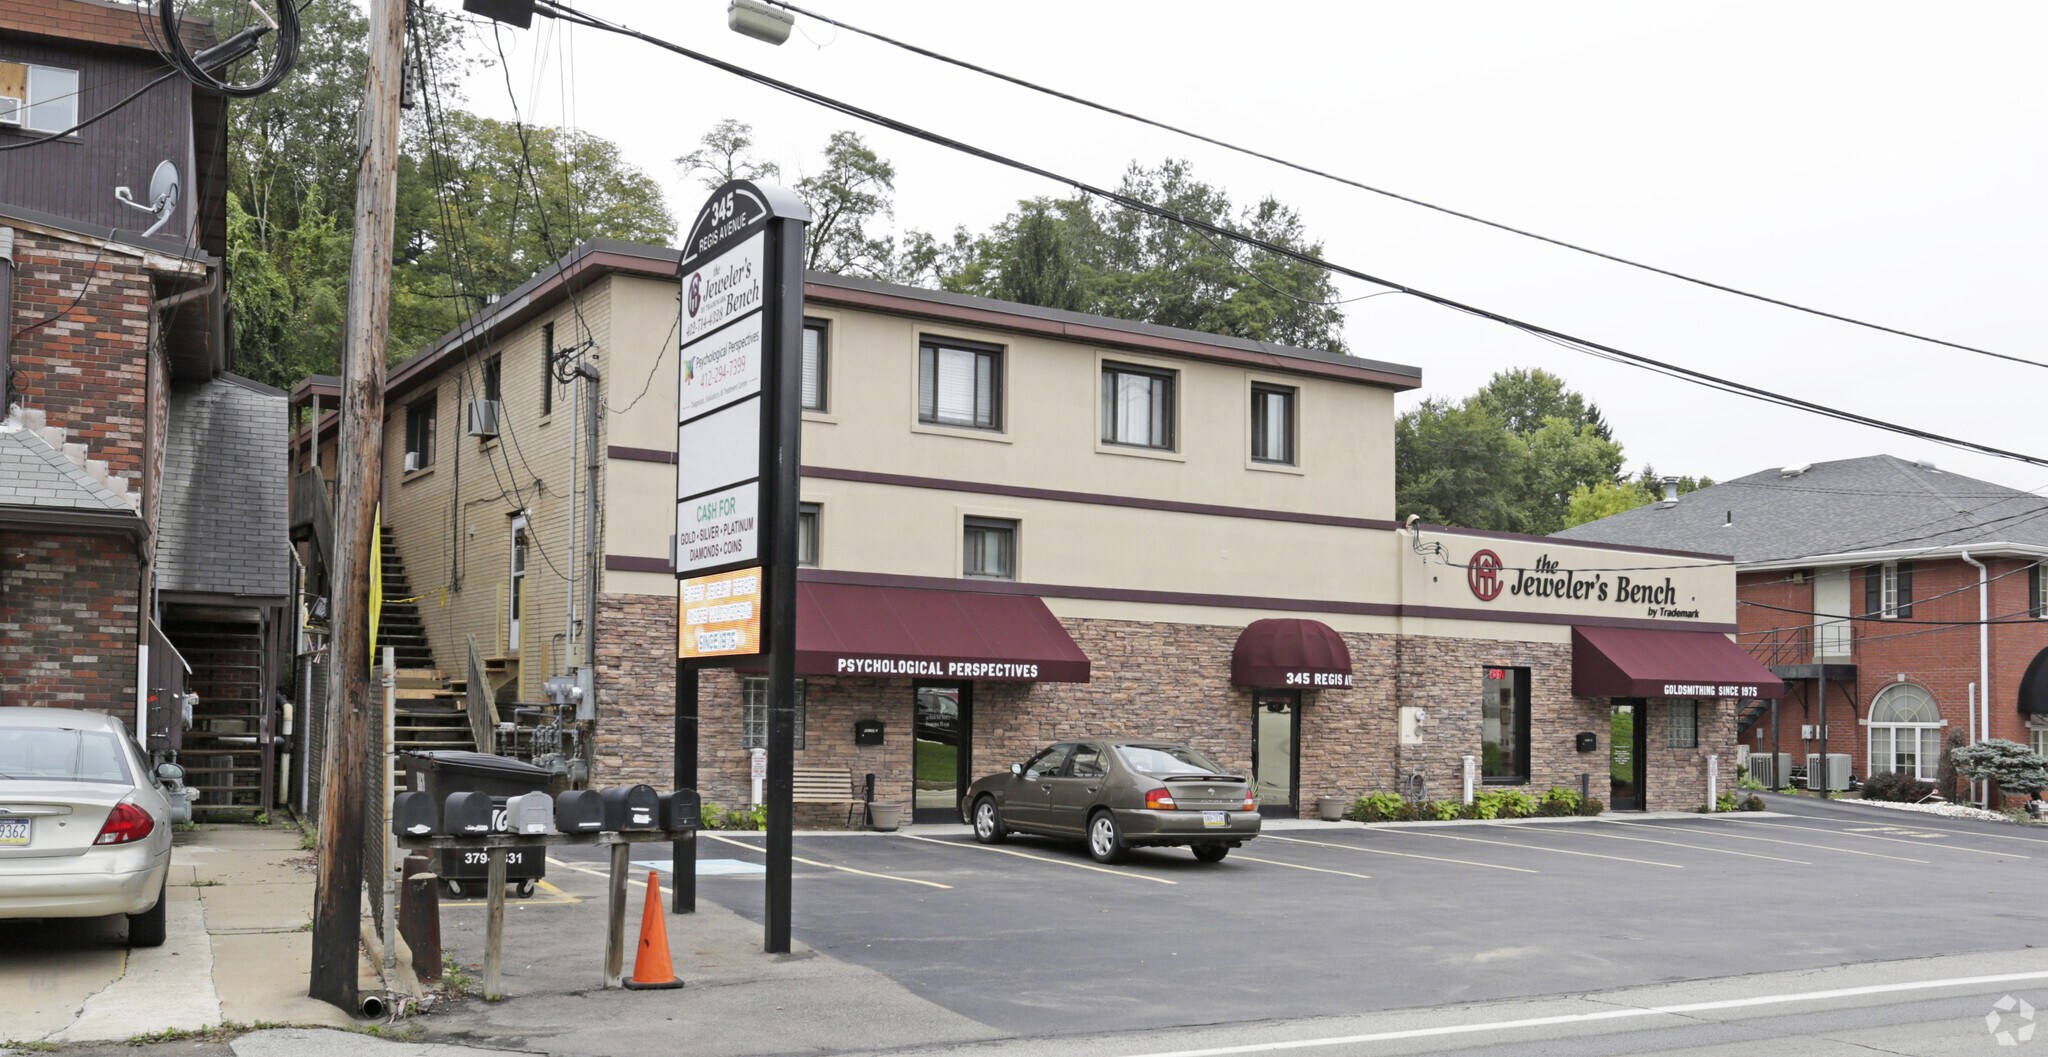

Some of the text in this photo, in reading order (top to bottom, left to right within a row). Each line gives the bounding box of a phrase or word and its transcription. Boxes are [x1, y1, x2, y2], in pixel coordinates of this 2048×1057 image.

[711, 192, 734, 227] 345
[699, 212, 746, 252] REGIS AVENUE
[703, 258, 752, 302] Jeweler's
[712, 264, 721, 277] the
[726, 279, 760, 316] Bench
[696, 331, 760, 370] Psychological Perspectives
[719, 497, 736, 518] FOR
[681, 517, 754, 546] GOLD SILVER PLATINUM
[690, 539, 742, 562] DIAMONDS COINS
[1535, 554, 1559, 574] the
[1511, 568, 1676, 605] Jeweler's Bench
[1648, 607, 1699, 618] by Trademark
[838, 658, 1038, 678] PSYCHOLOGICAL PERSPECTIVES
[1286, 672, 1310, 684] 345
[1314, 673, 1343, 685] REGIS
[1664, 685, 1758, 697] GOLDSMITHING SINCE 1975
